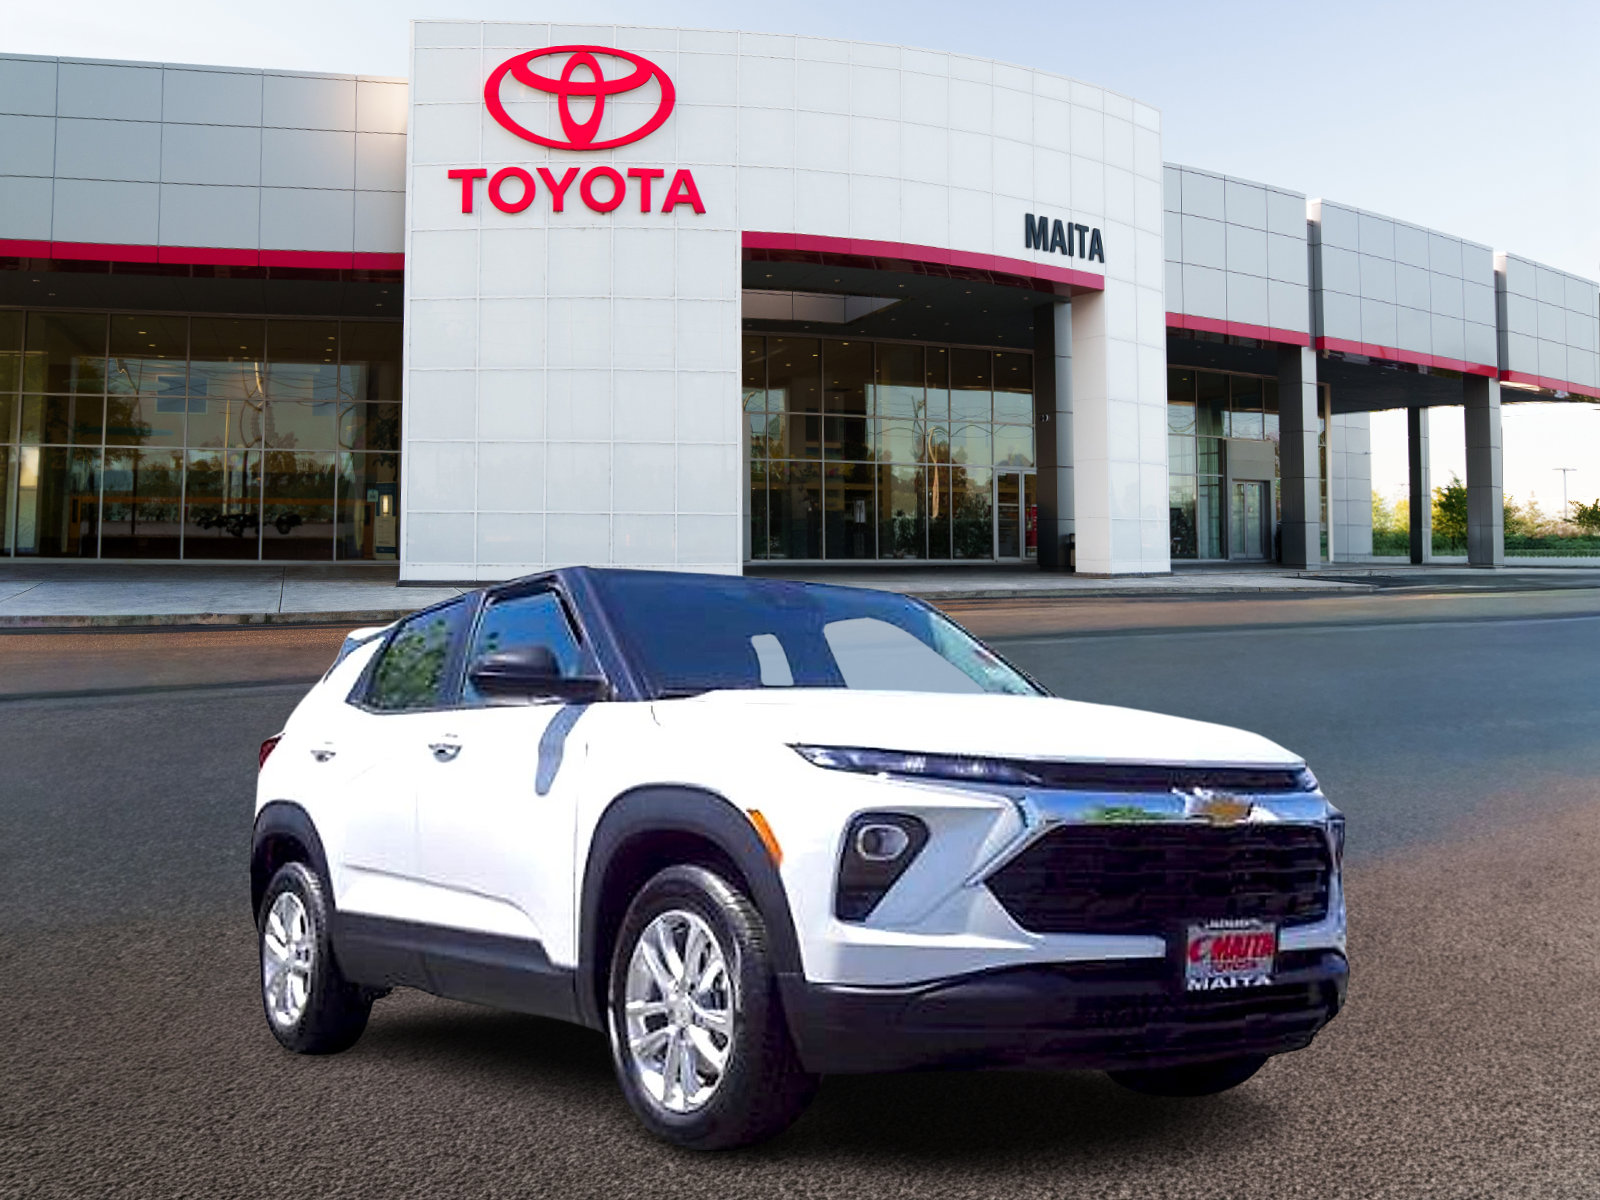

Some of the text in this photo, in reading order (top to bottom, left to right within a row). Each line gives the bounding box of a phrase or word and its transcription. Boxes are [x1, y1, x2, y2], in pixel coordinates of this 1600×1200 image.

[448, 165, 706, 214] TOYOTA
[1025, 213, 1104, 263] MAITA
[1187, 976, 1271, 990] MAITA
